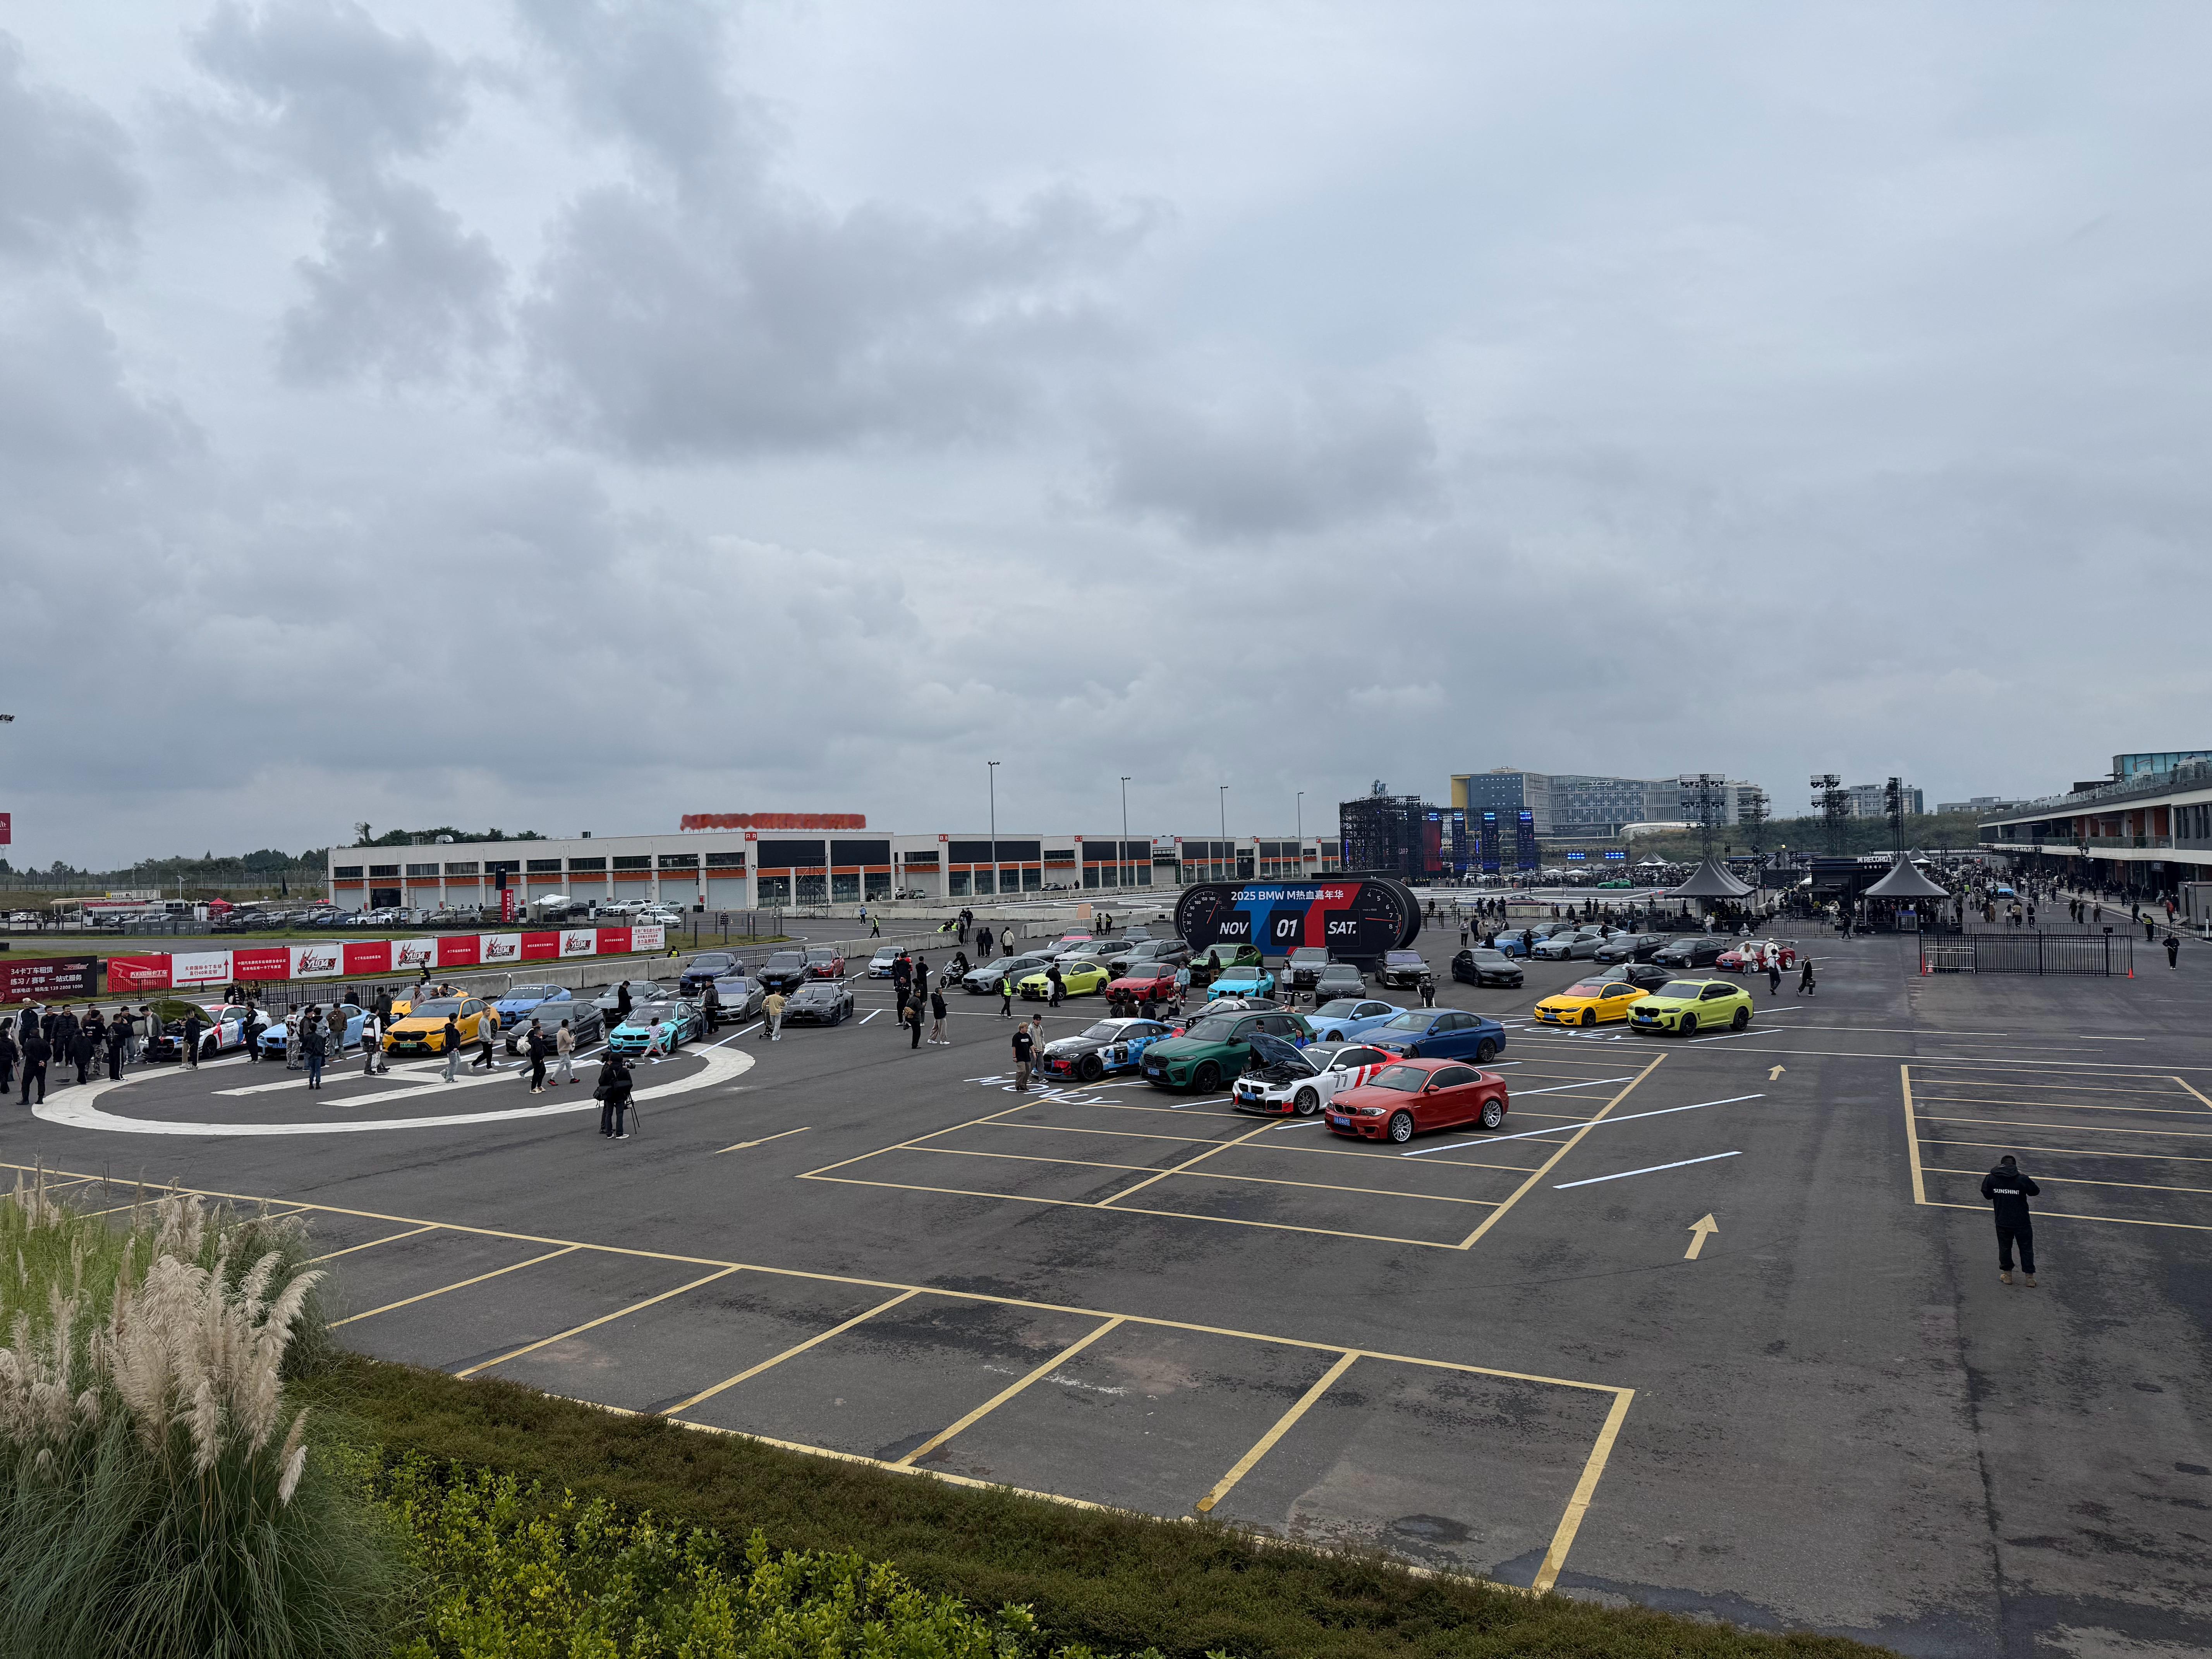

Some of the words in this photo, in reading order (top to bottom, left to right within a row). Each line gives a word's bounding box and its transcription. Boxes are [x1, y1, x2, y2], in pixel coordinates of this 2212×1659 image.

[1231, 891, 1256, 900] 2025
[1259, 891, 1284, 900] BMW
[1287, 890, 1344, 900] M热血嘉年华
[1220, 922, 1249, 934] NOV
[1276, 919, 1297, 937] 01
[1328, 921, 1357, 934] SAT.
[11, 967, 53, 975] 34卡丁车租赁
[49, 974, 82, 982] 一站式服务
[1524, 1027, 1644, 1041] ONLY
[1333, 1074, 1348, 1088] 77
[1001, 1084, 1123, 1105] ONLY
